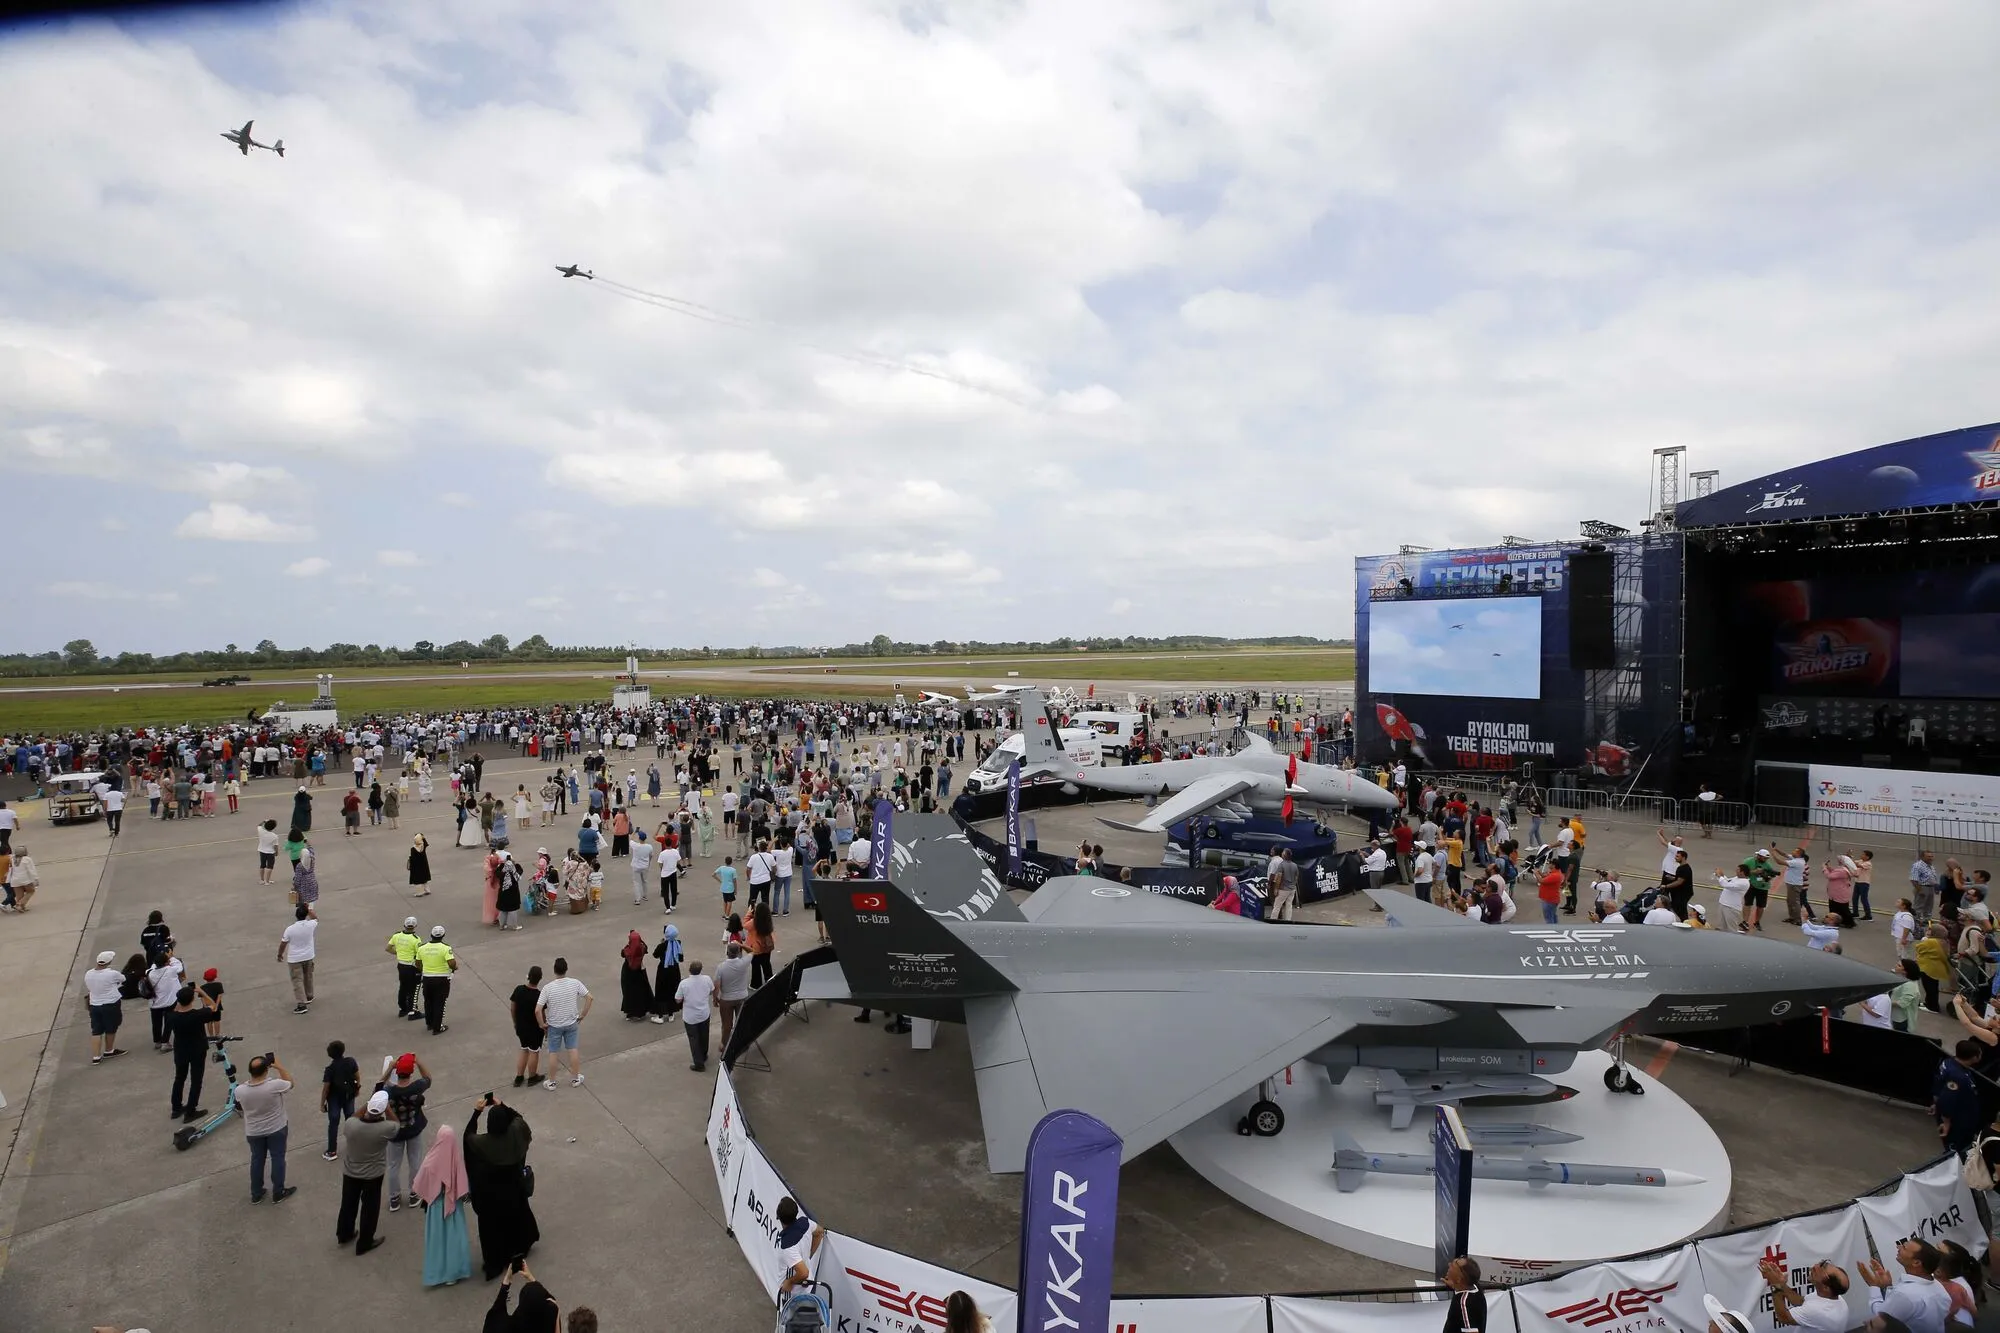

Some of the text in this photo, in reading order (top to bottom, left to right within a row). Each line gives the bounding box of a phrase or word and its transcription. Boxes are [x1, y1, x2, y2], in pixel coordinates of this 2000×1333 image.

[1784, 652, 1869, 677] TEKNOFEST
[1467, 720, 1530, 740] AYAKLARI
[1446, 735, 1478, 753] YERE
[1008, 776, 1017, 845] BAYKAR
[1816, 799, 1825, 808] 30
[874, 821, 887, 880] YKAR
[1151, 884, 1206, 896] BAYKAR
[855, 914, 890, 924] TC-ÖZB
[1536, 945, 1618, 953] BAYRAKTAR
[888, 965, 957, 973] KIZILELMA
[1520, 954, 1647, 967] KIZILELMA
[754, 1200, 782, 1250] BAYK
[1044, 1170, 1089, 1332] YKAR
